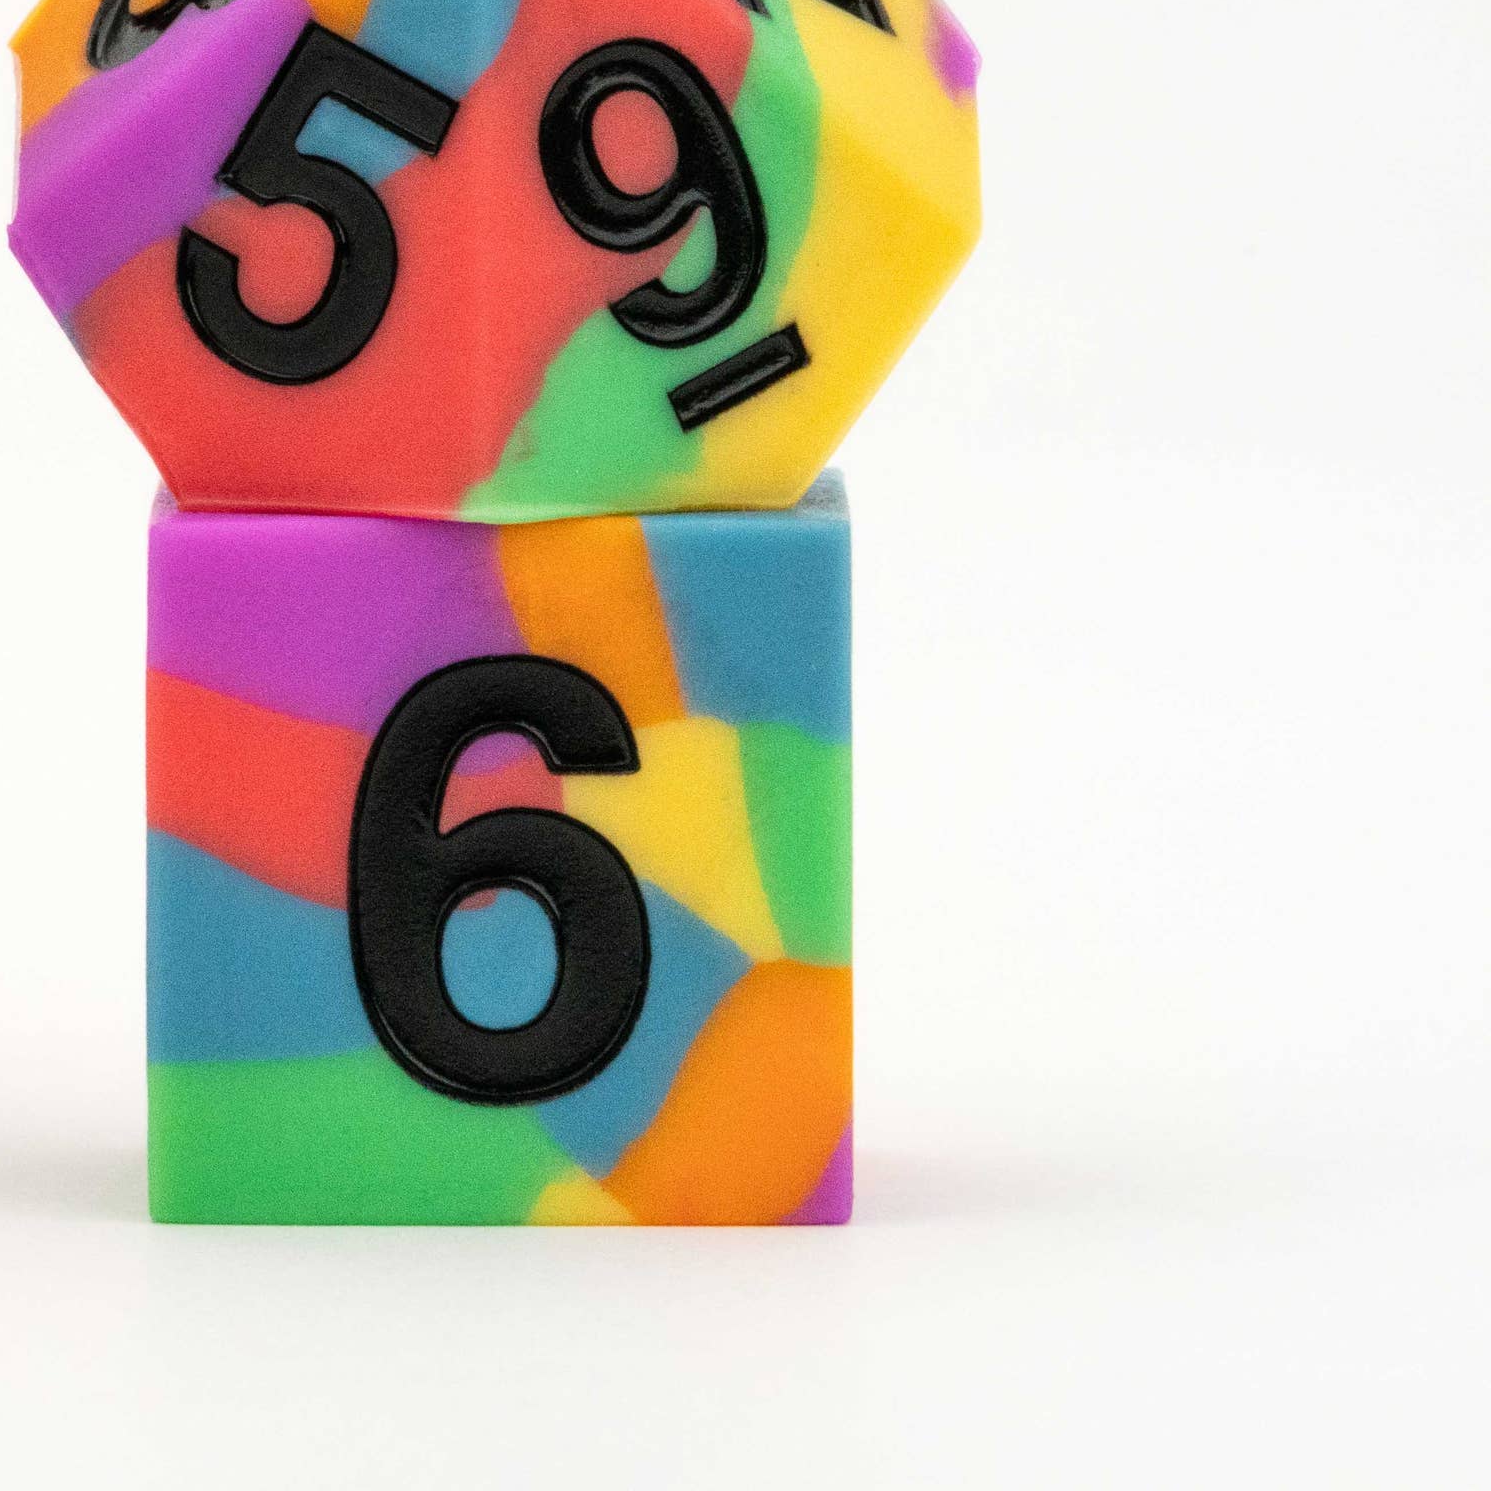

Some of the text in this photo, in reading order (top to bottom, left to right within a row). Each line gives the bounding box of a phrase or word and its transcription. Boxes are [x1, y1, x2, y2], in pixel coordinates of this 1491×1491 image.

[174, 18, 461, 388] 5
[536, 36, 769, 350] 9
[345, 652, 654, 1107] 6
